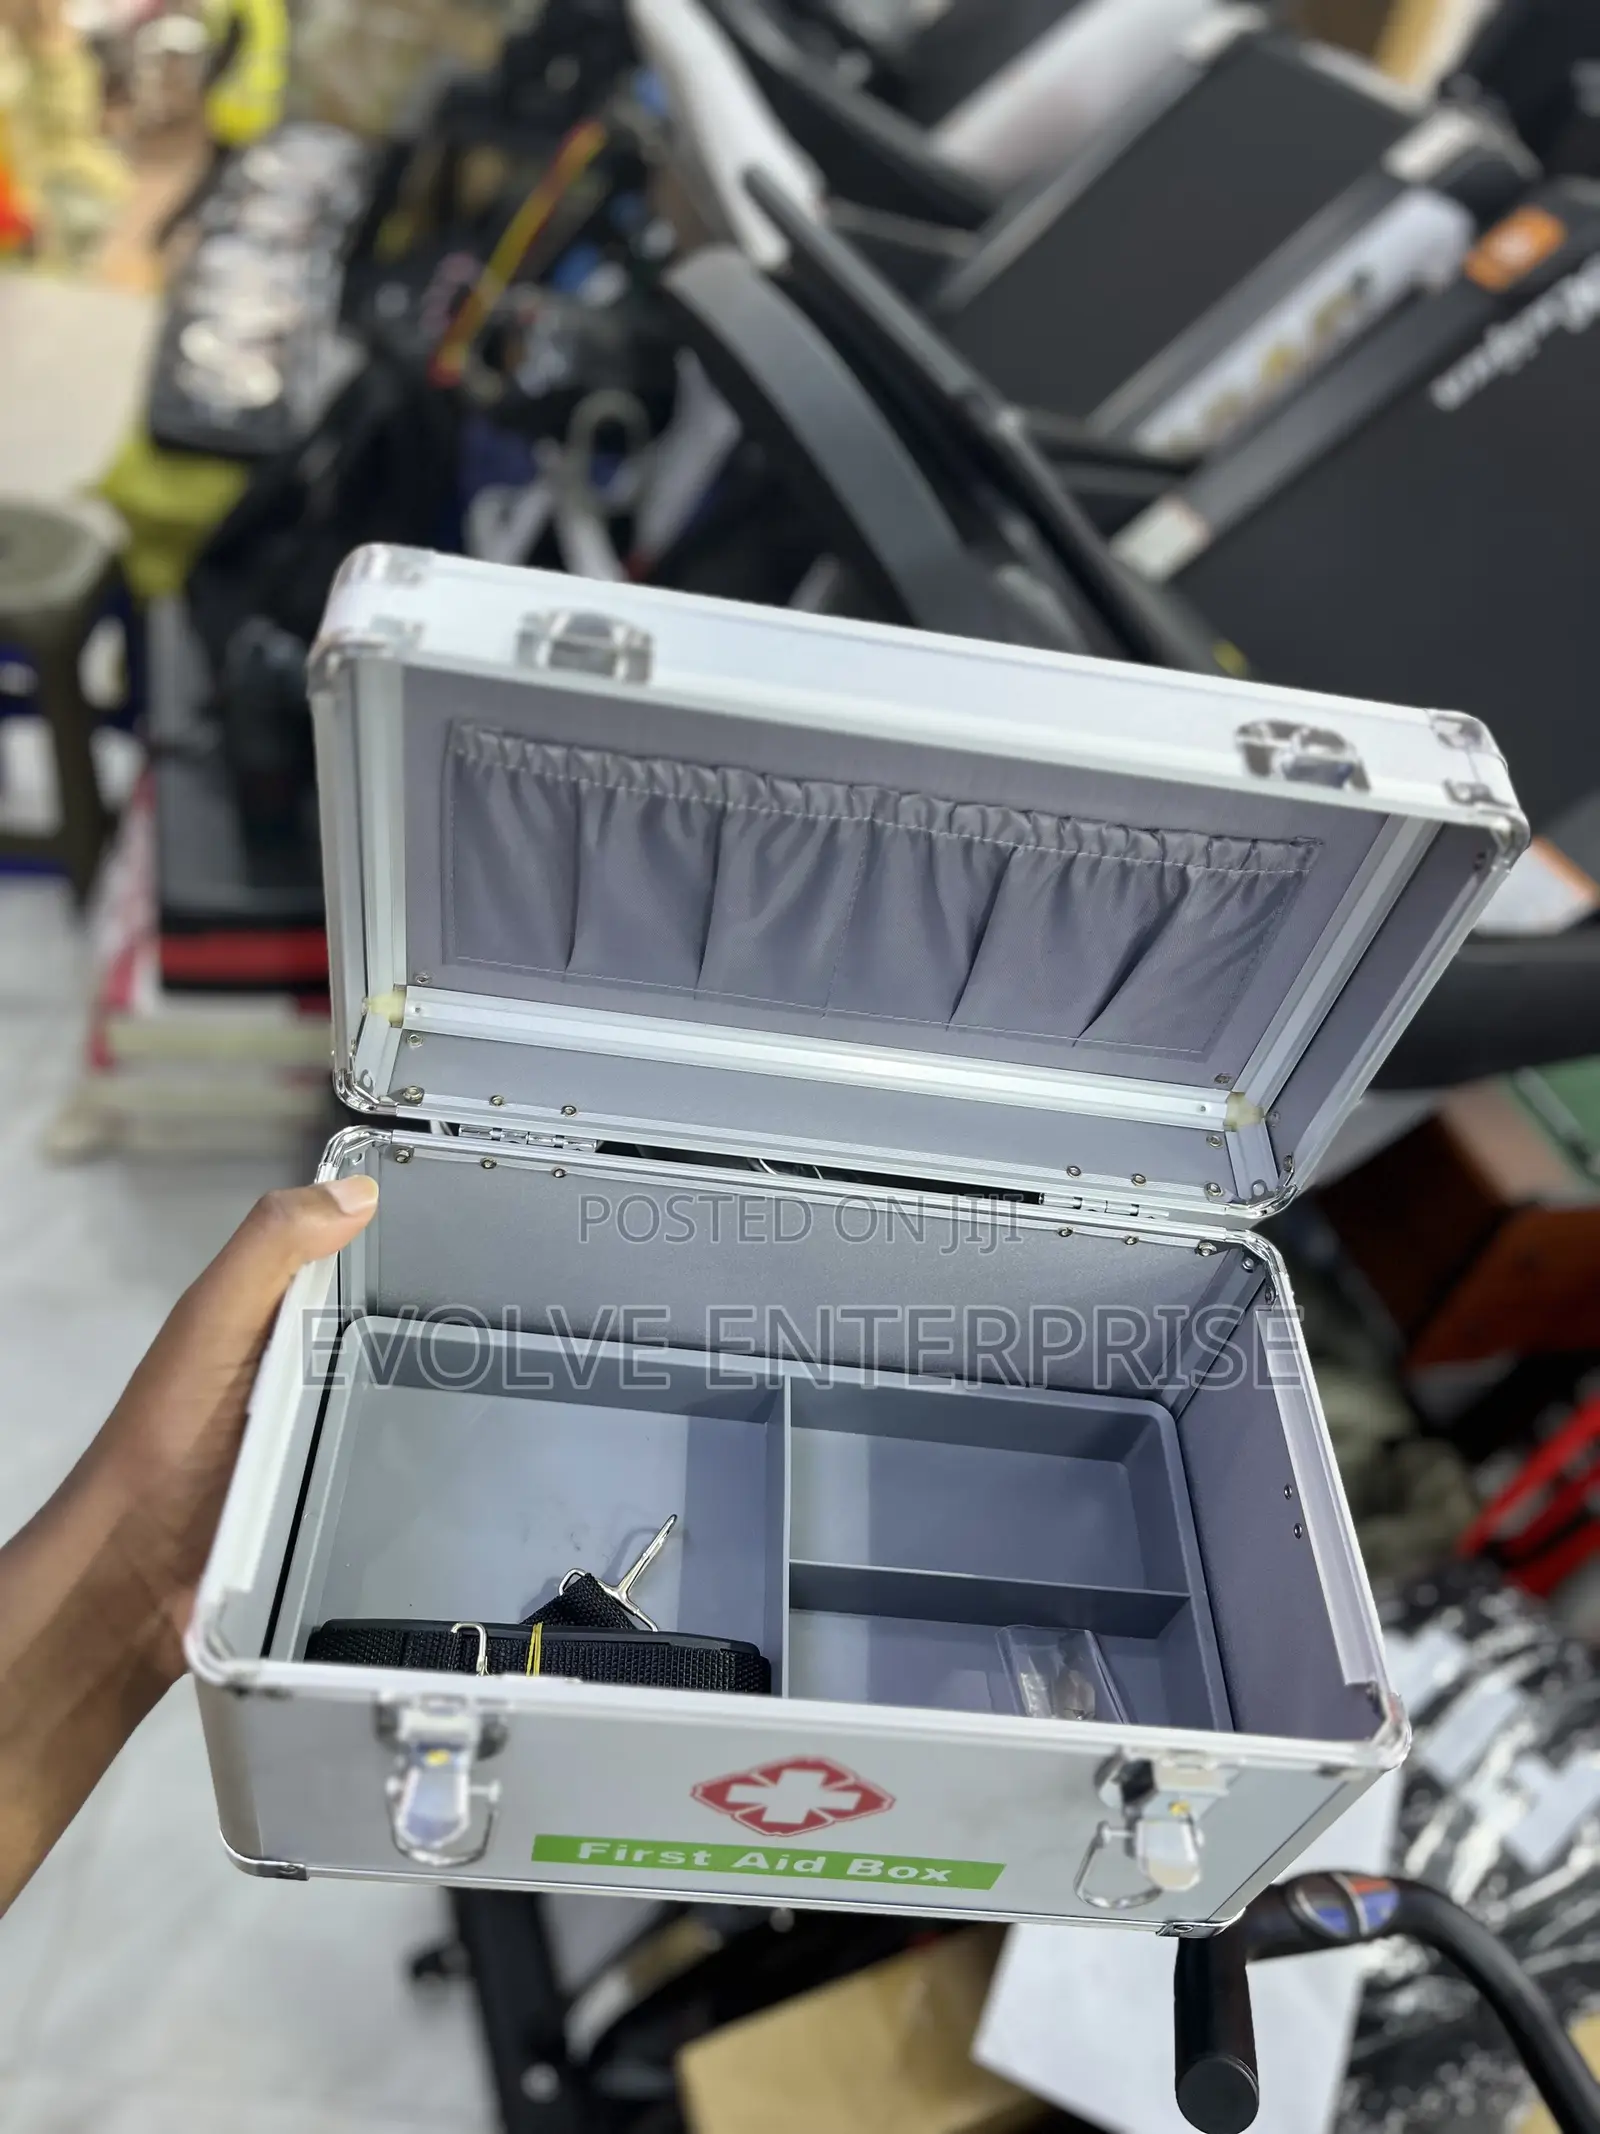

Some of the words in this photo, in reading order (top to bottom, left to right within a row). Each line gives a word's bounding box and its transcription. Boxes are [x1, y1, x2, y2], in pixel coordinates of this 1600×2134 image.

[578, 1841, 711, 1867] First
[731, 1851, 825, 1874] Aid
[845, 1859, 953, 1882] Box
